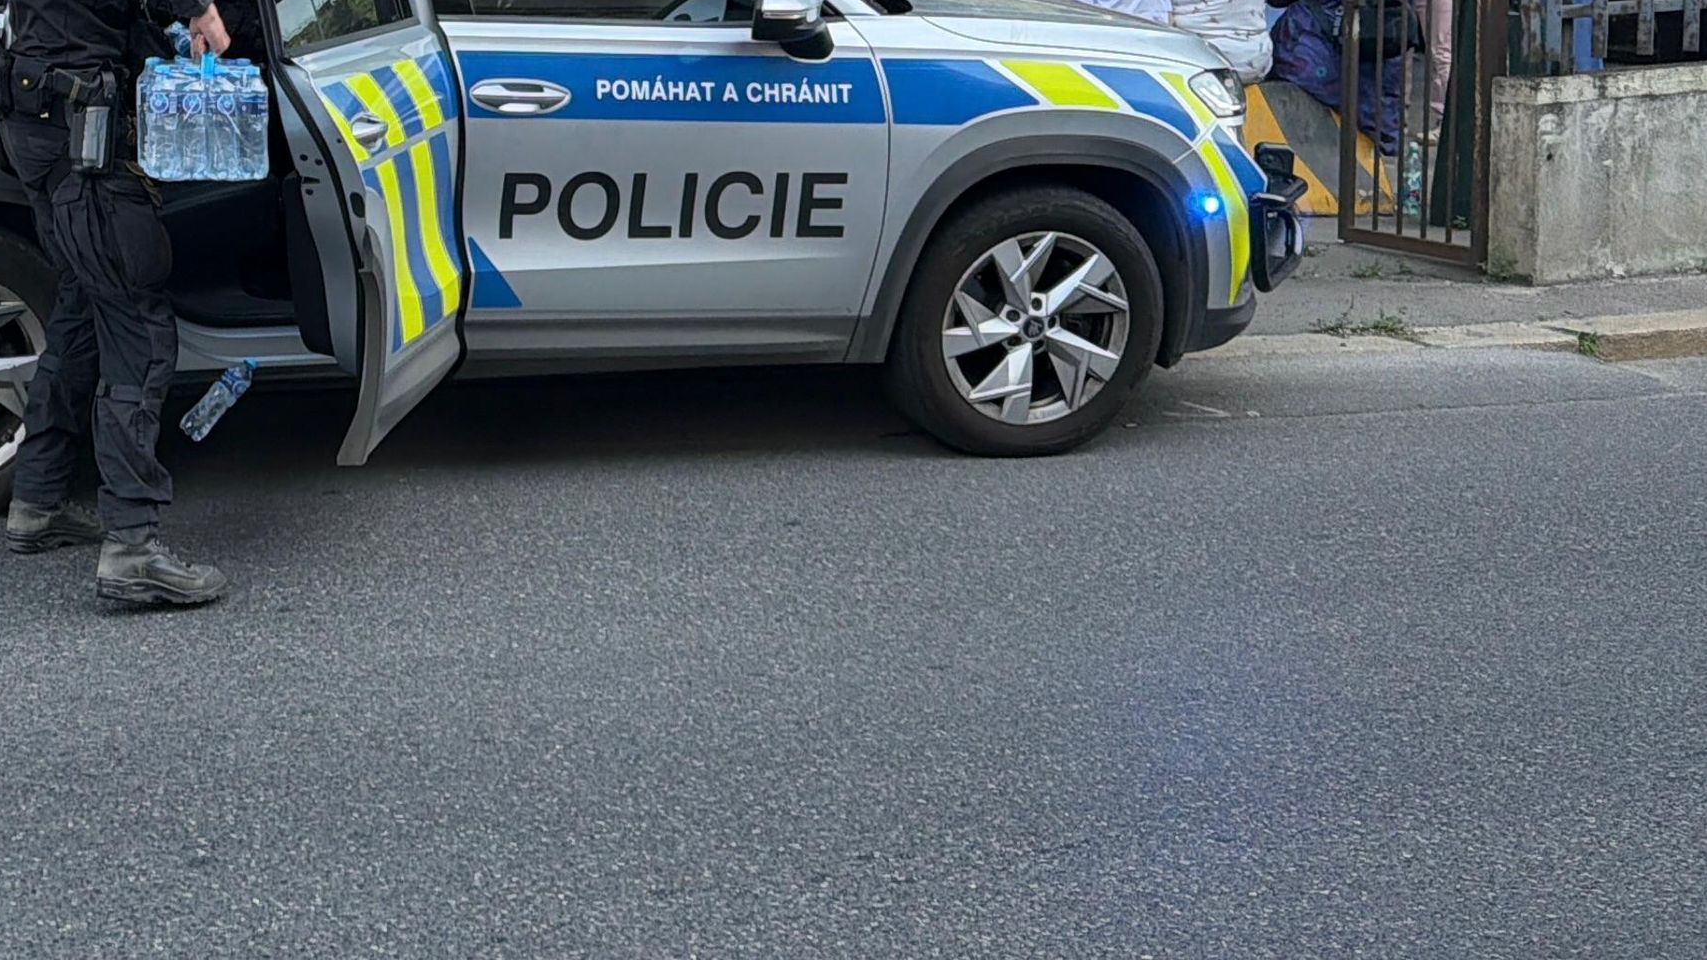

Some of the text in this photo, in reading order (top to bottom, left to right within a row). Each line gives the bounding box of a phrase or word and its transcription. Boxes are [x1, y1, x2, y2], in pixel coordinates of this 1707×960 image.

[596, 75, 853, 104] POMÁHAT A CHRÁNIT
[498, 171, 849, 240] POLICIE
